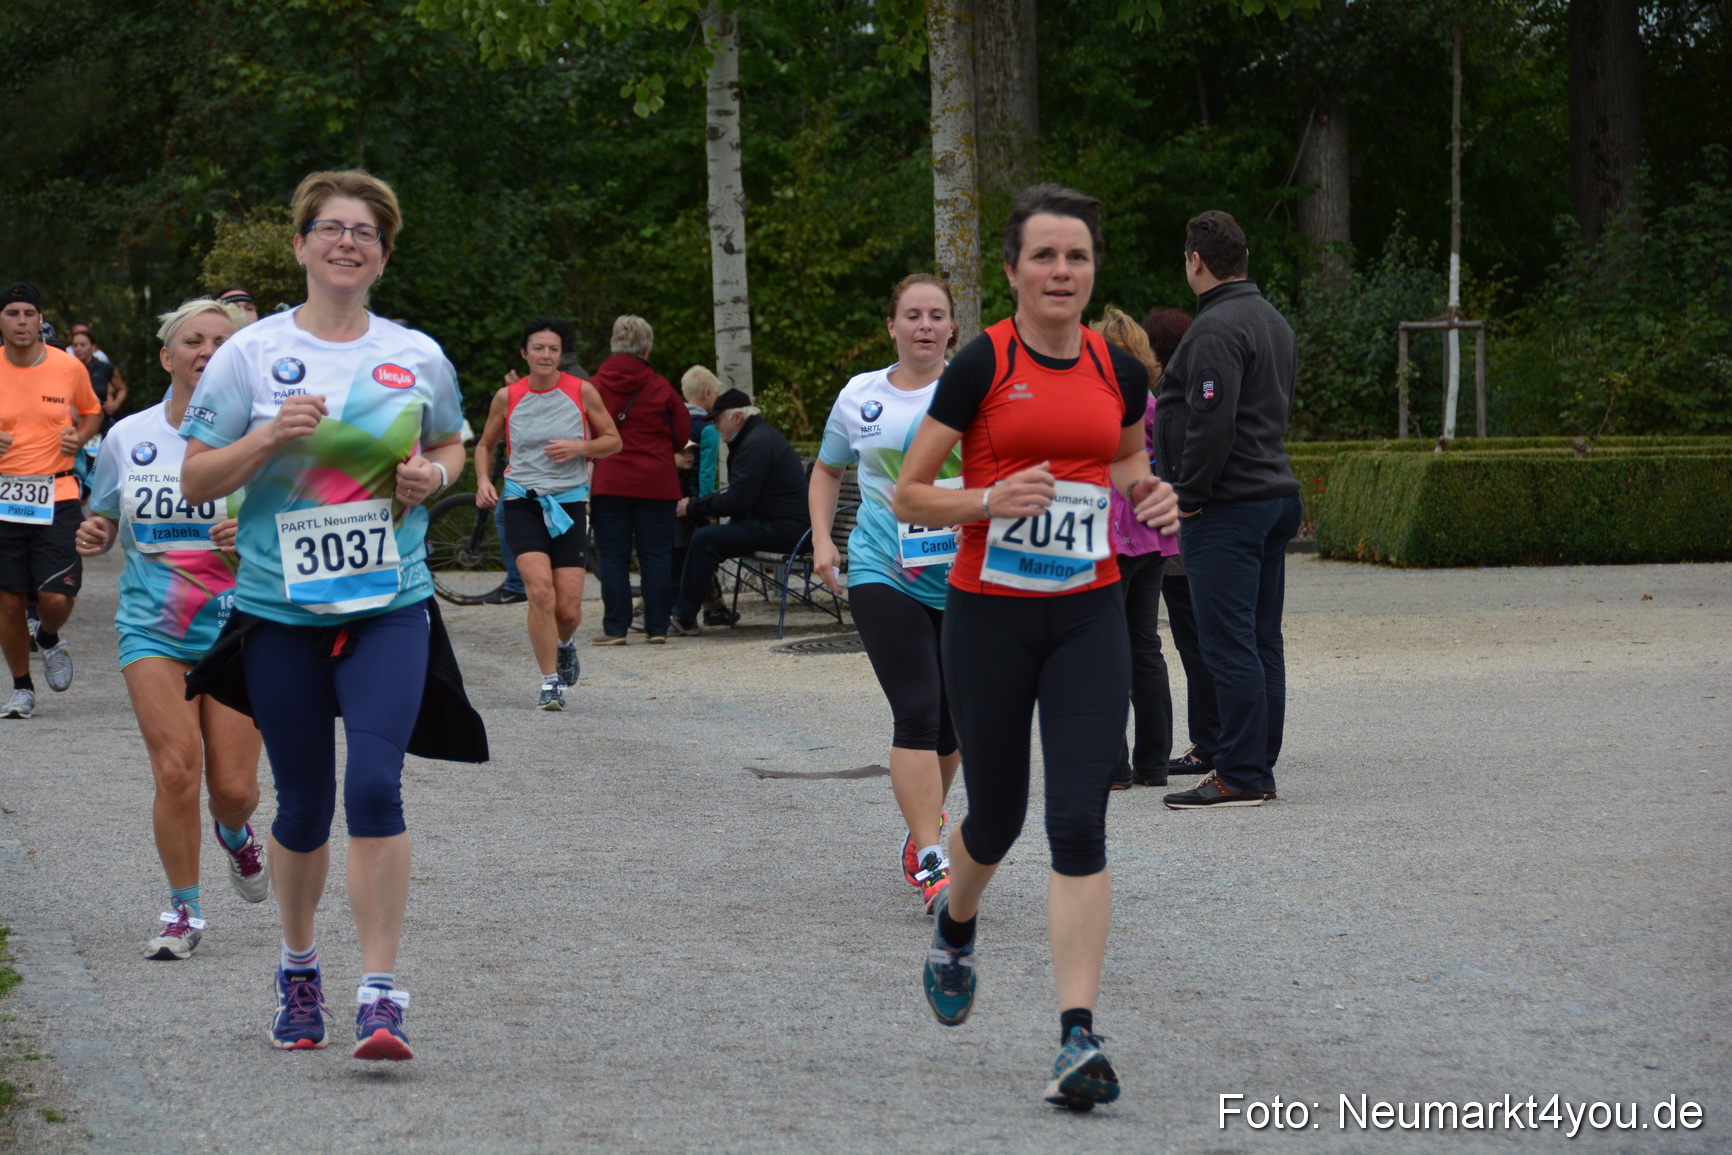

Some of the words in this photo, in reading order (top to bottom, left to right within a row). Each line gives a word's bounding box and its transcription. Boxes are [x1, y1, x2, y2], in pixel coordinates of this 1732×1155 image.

[379, 368, 412, 384] Hervis
[274, 387, 310, 399] PARTL
[185, 406, 215, 423] BCK
[861, 424, 882, 433] PARTL
[128, 474, 160, 483] PARTL
[0, 482, 49, 505] 2330
[1053, 495, 1094, 507] umarkt
[8, 506, 36, 517] Patrick
[281, 519, 321, 534] PARTL
[324, 511, 377, 528] Neumarkt
[153, 526, 200, 541] Izabela
[1002, 509, 1095, 553] 2041
[295, 527, 387, 576] 3037
[921, 539, 957, 554] Caroli
[1018, 556, 1076, 579] Marion
